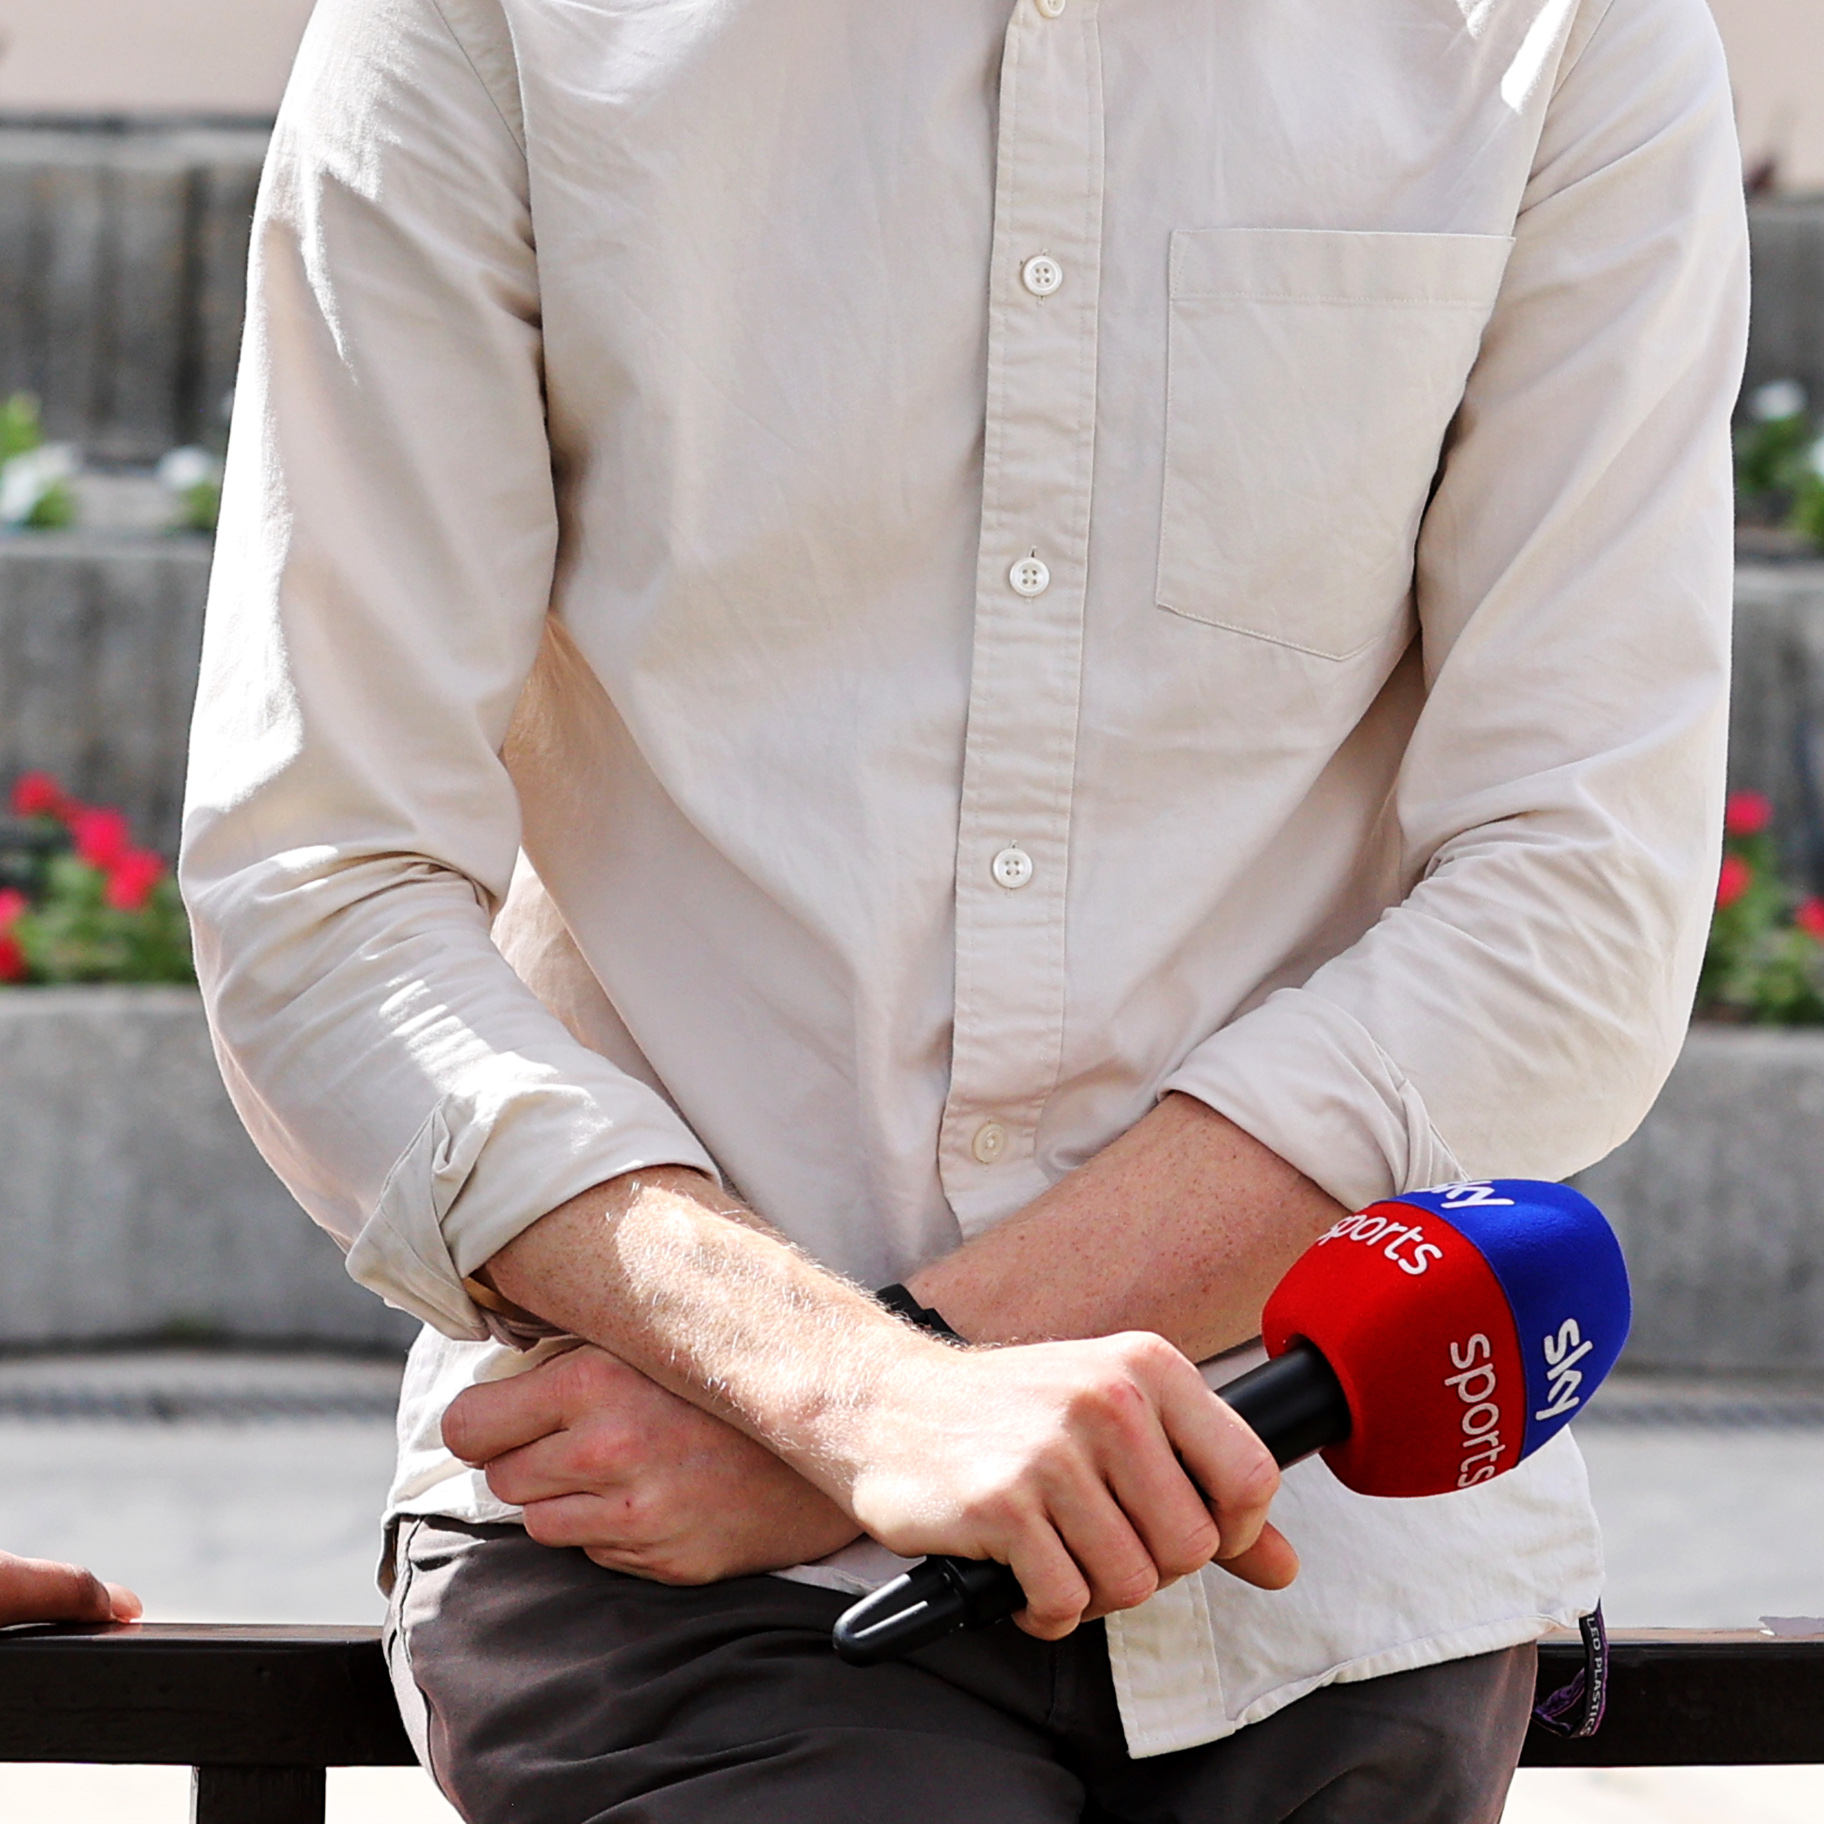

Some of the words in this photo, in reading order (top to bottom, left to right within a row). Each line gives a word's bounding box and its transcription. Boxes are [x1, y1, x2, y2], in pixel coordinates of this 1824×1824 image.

[1444, 1333, 1507, 1488] sports
[1535, 1318, 1594, 1421] sky
[1578, 1656, 1603, 1736] PLASTICS
